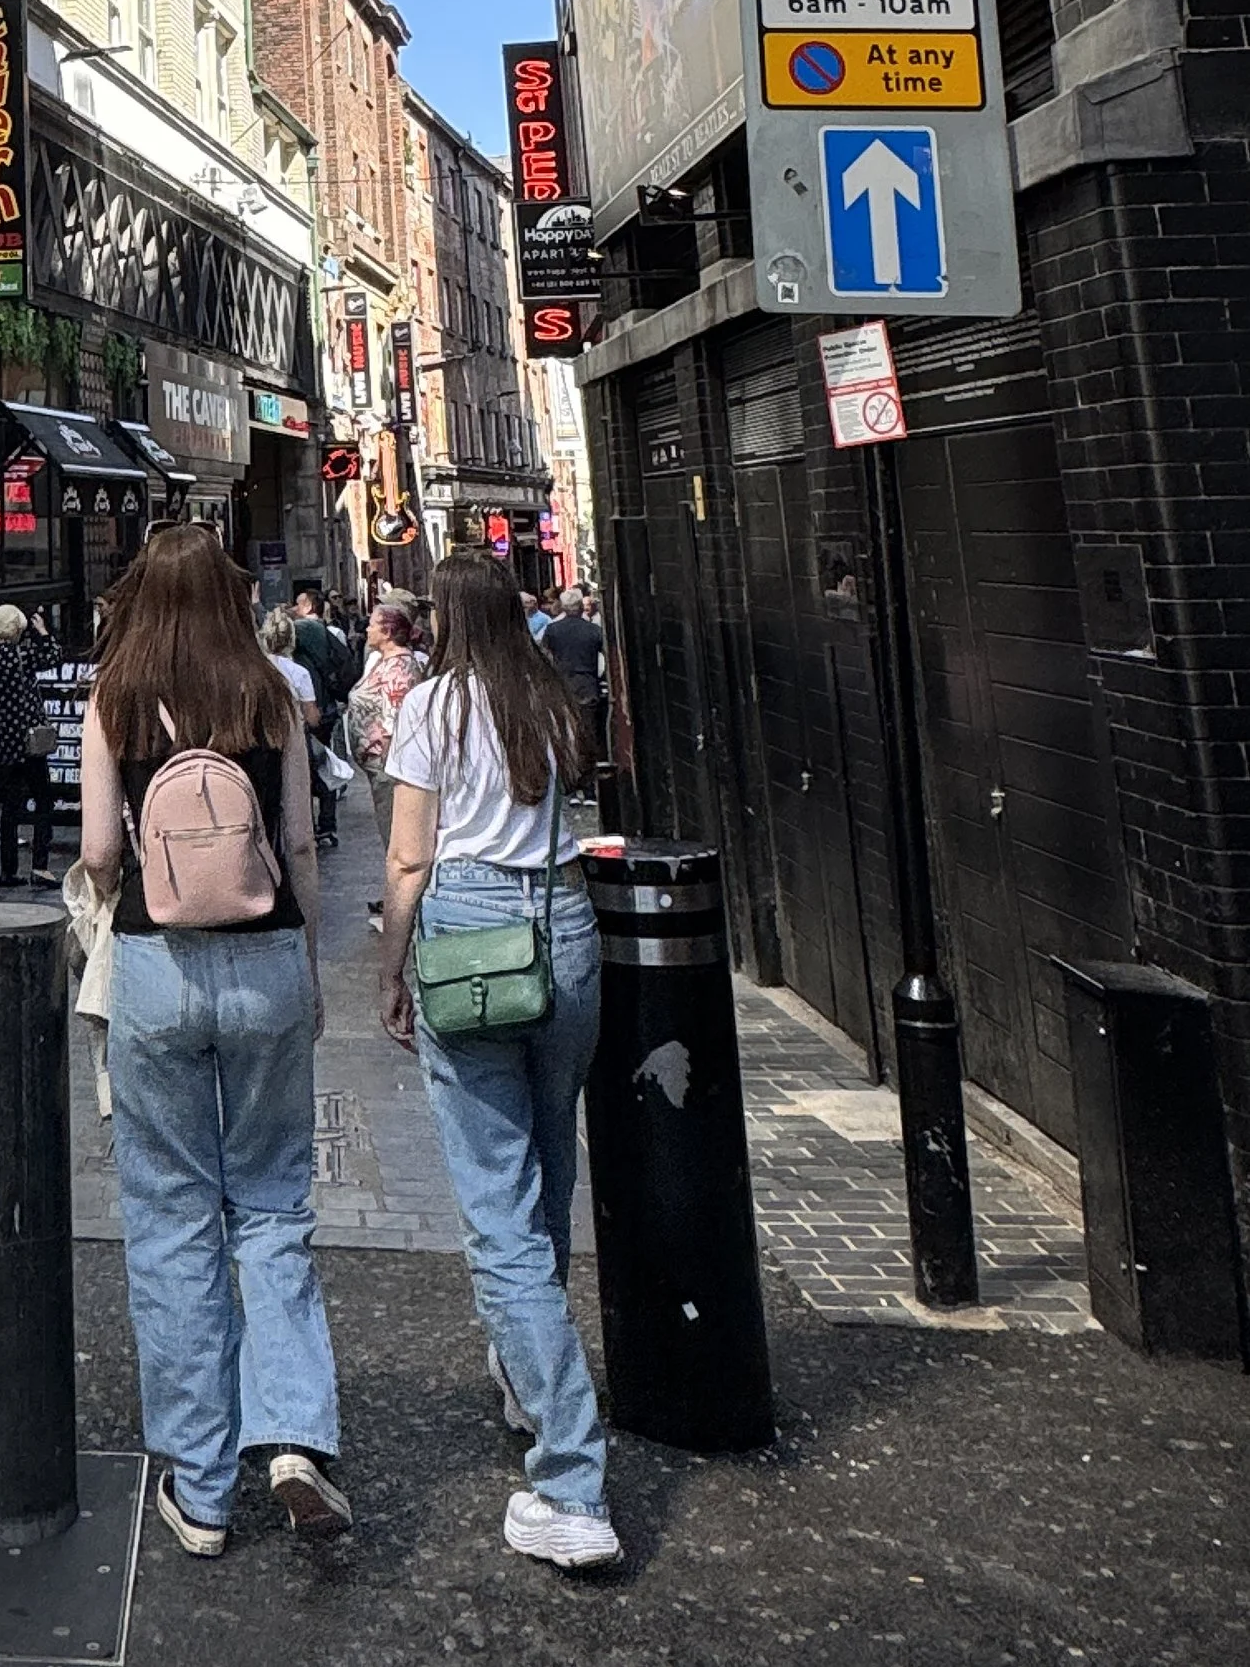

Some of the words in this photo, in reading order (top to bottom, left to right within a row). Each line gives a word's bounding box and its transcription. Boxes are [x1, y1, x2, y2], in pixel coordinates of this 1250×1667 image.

[867, 44, 900, 65] At
[908, 48, 955, 70] any
[882, 71, 943, 93] time
[162, 380, 191, 423] THE
